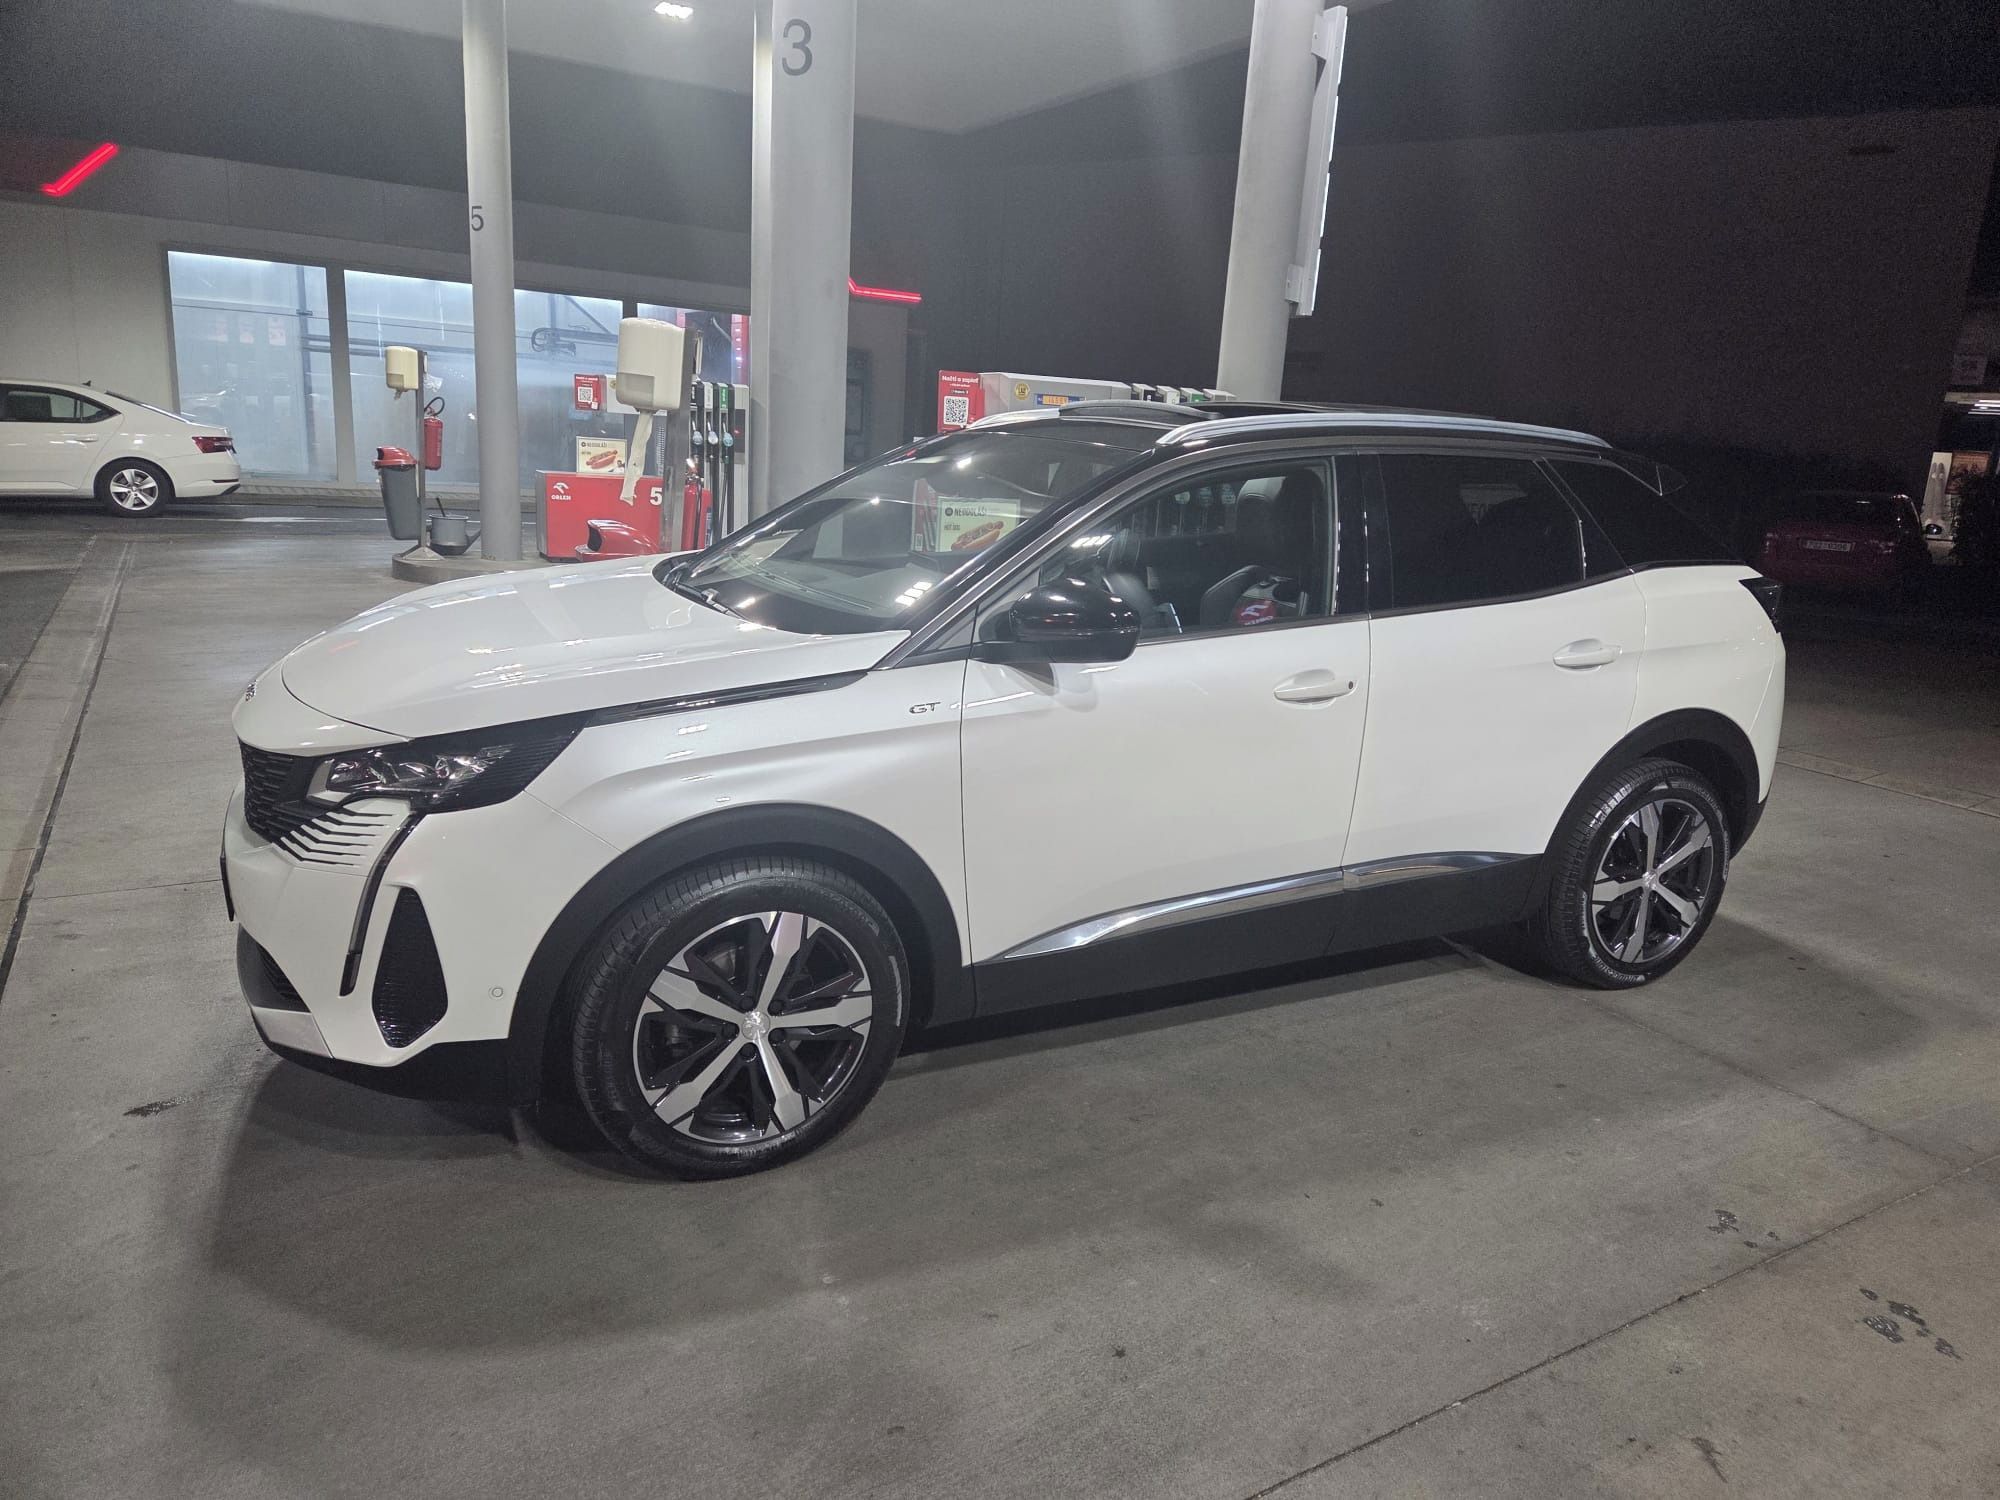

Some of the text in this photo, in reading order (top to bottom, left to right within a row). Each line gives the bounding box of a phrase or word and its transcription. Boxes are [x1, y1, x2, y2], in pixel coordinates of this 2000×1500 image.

[782, 18, 813, 76] 3
[471, 205, 484, 232] 5
[650, 486, 663, 506] 5
[909, 701, 942, 714] GT
